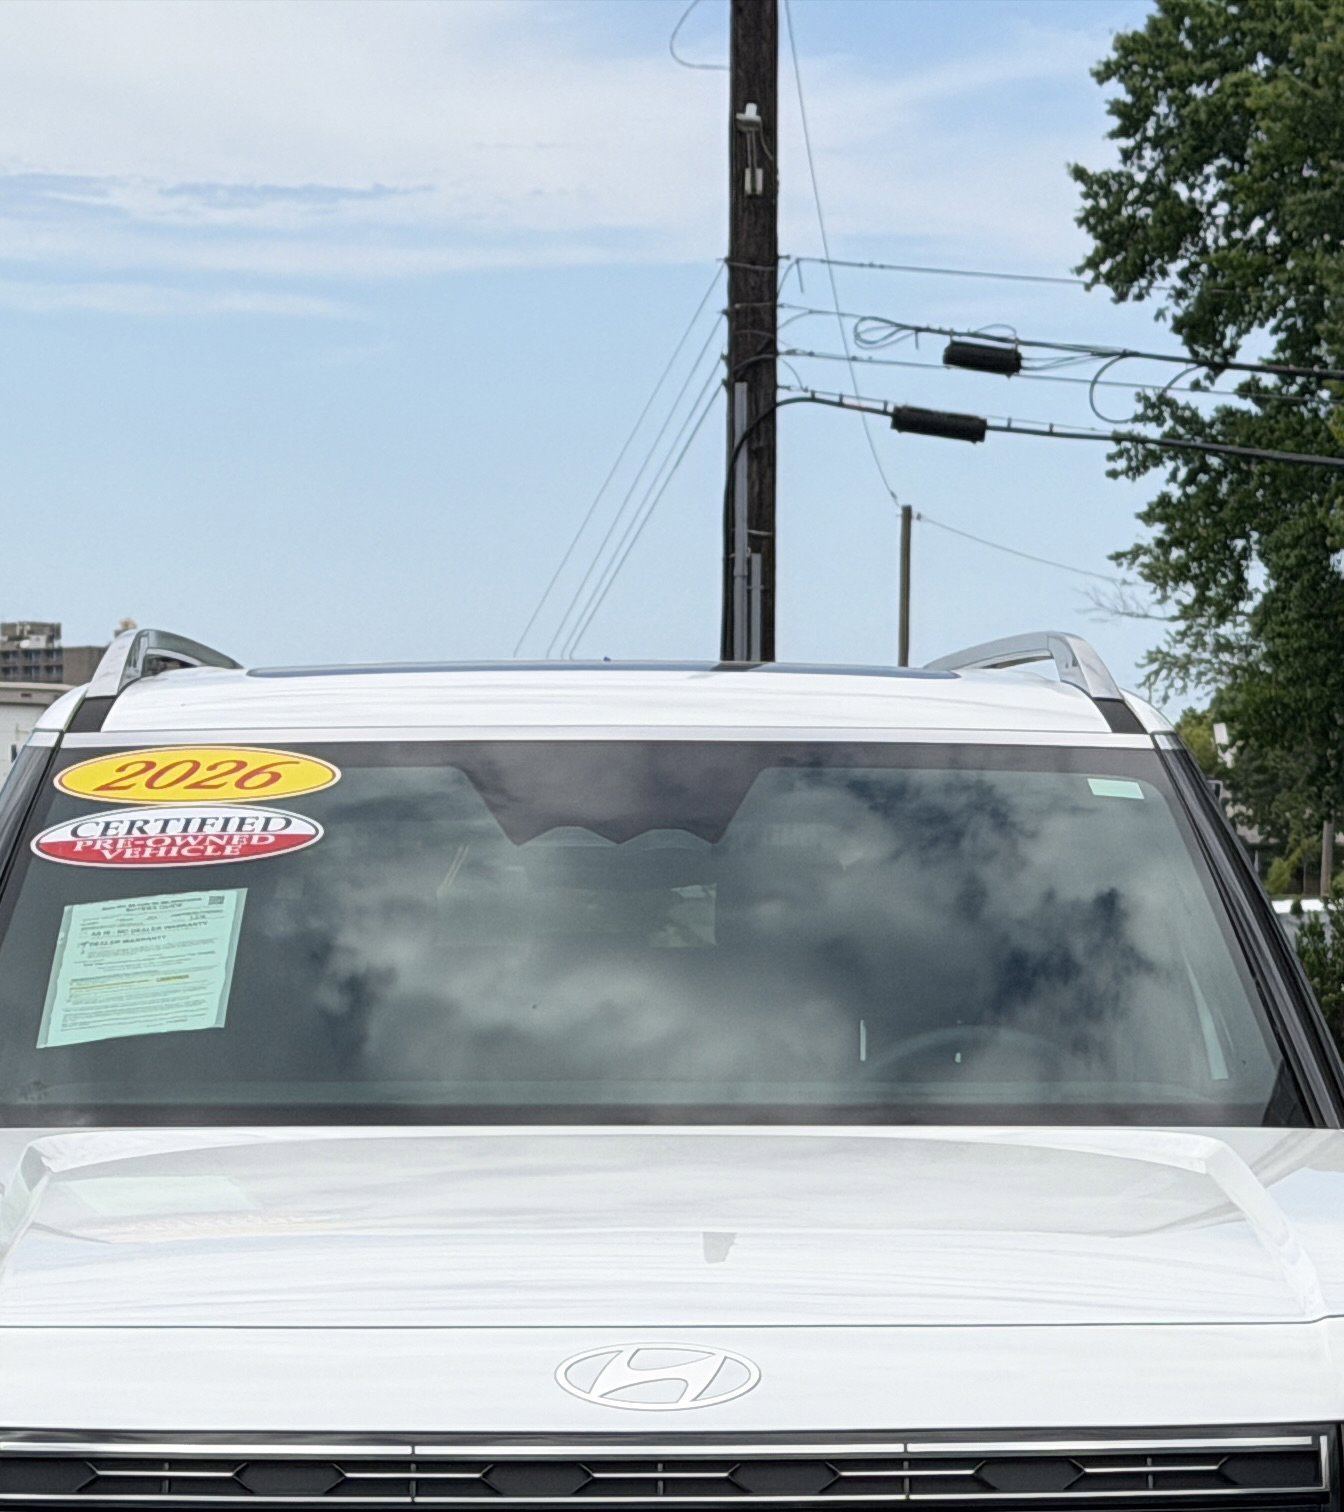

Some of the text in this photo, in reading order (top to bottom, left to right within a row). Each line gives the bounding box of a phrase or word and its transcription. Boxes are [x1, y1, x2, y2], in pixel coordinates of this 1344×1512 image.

[93, 758, 300, 792] 2026
[70, 816, 293, 839] CERTIFIED
[73, 834, 277, 852] PRE-OWNED
[100, 844, 243, 861] VEHICLE
